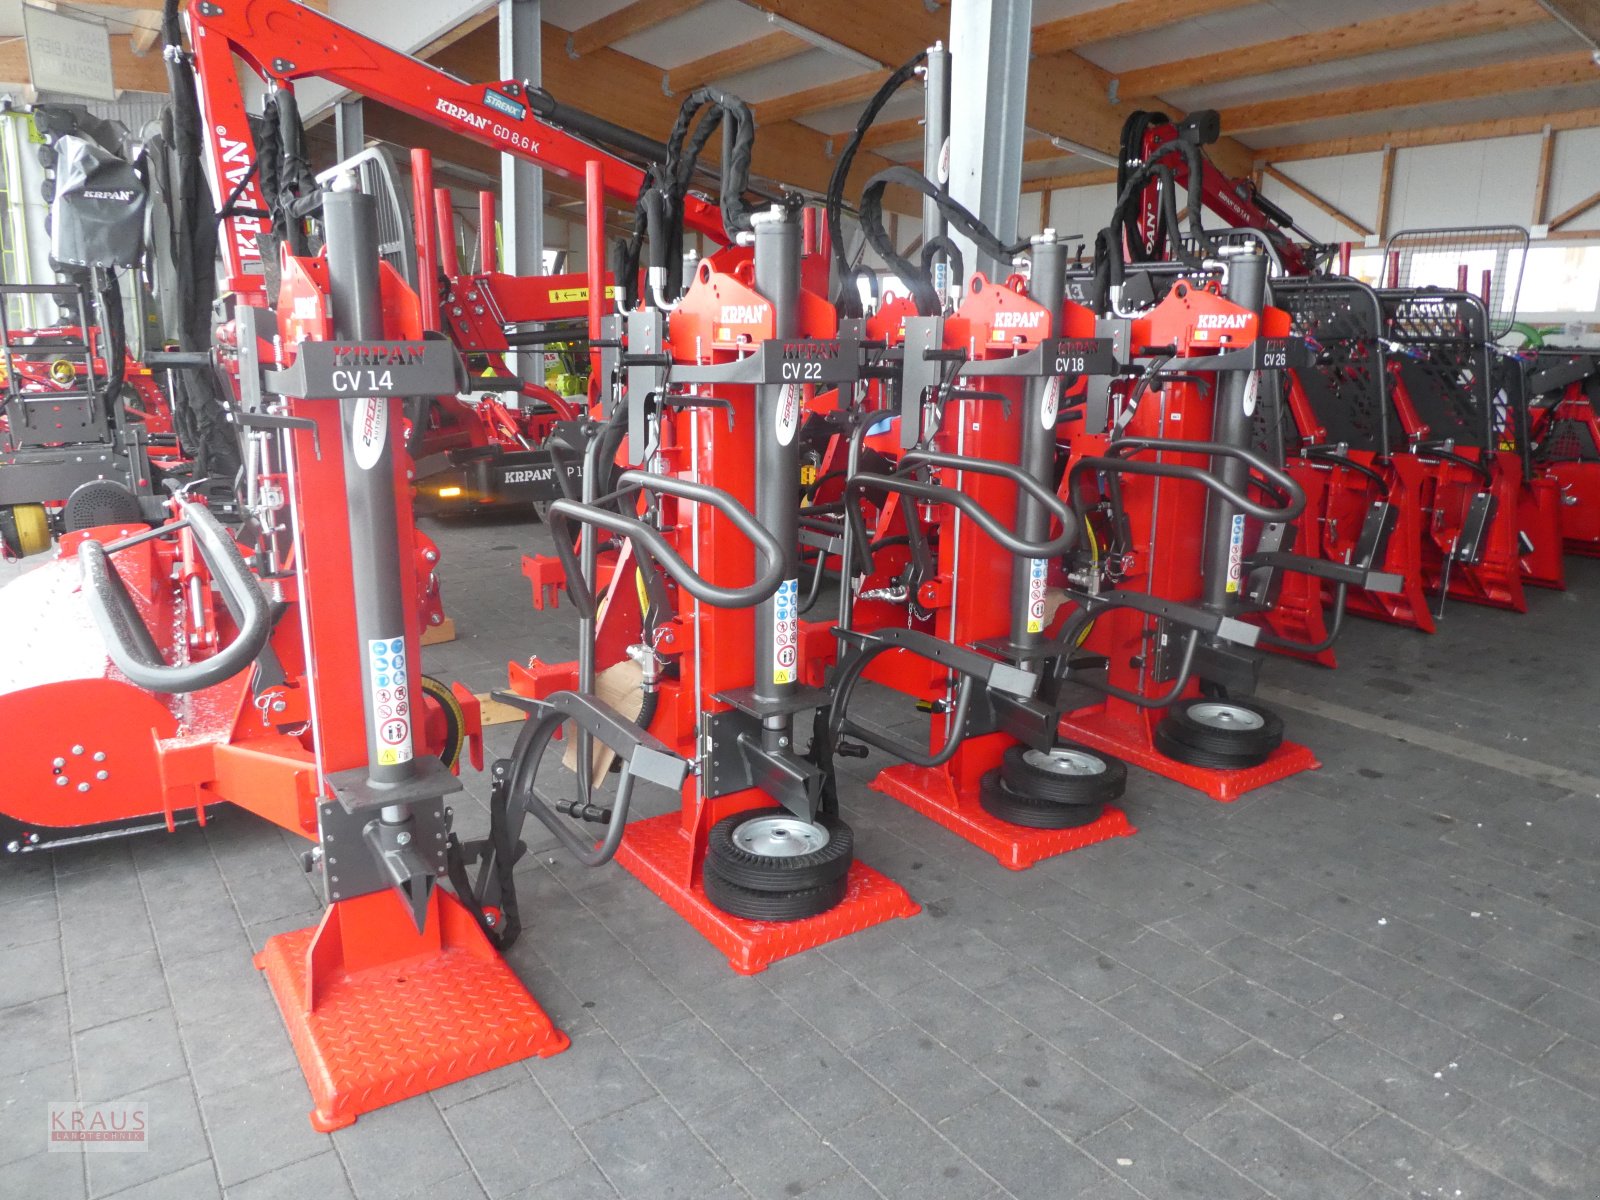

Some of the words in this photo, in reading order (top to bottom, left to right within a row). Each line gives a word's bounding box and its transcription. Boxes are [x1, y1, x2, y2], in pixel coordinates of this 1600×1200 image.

[485, 95, 519, 116] STRENX
[435, 98, 488, 130] KRPAN
[493, 124, 510, 140] GD
[530, 141, 540, 154] K
[83, 190, 130, 201] KRPAN
[721, 304, 763, 324] KRPAN
[994, 311, 1040, 328] KRPAN
[1197, 313, 1248, 329] KRPAN
[333, 345, 426, 367] KRPAN
[783, 343, 840, 360] KRPAN
[1263, 353, 1275, 366] CV
[1275, 353, 1286, 366] 26
[782, 362, 801, 379] CV
[804, 363, 822, 379] 22
[1055, 357, 1070, 372] CV
[1071, 357, 1084, 372] 18
[332, 370, 362, 391] CV
[368, 370, 394, 391] 14
[504, 468, 552, 483] KRPAN
